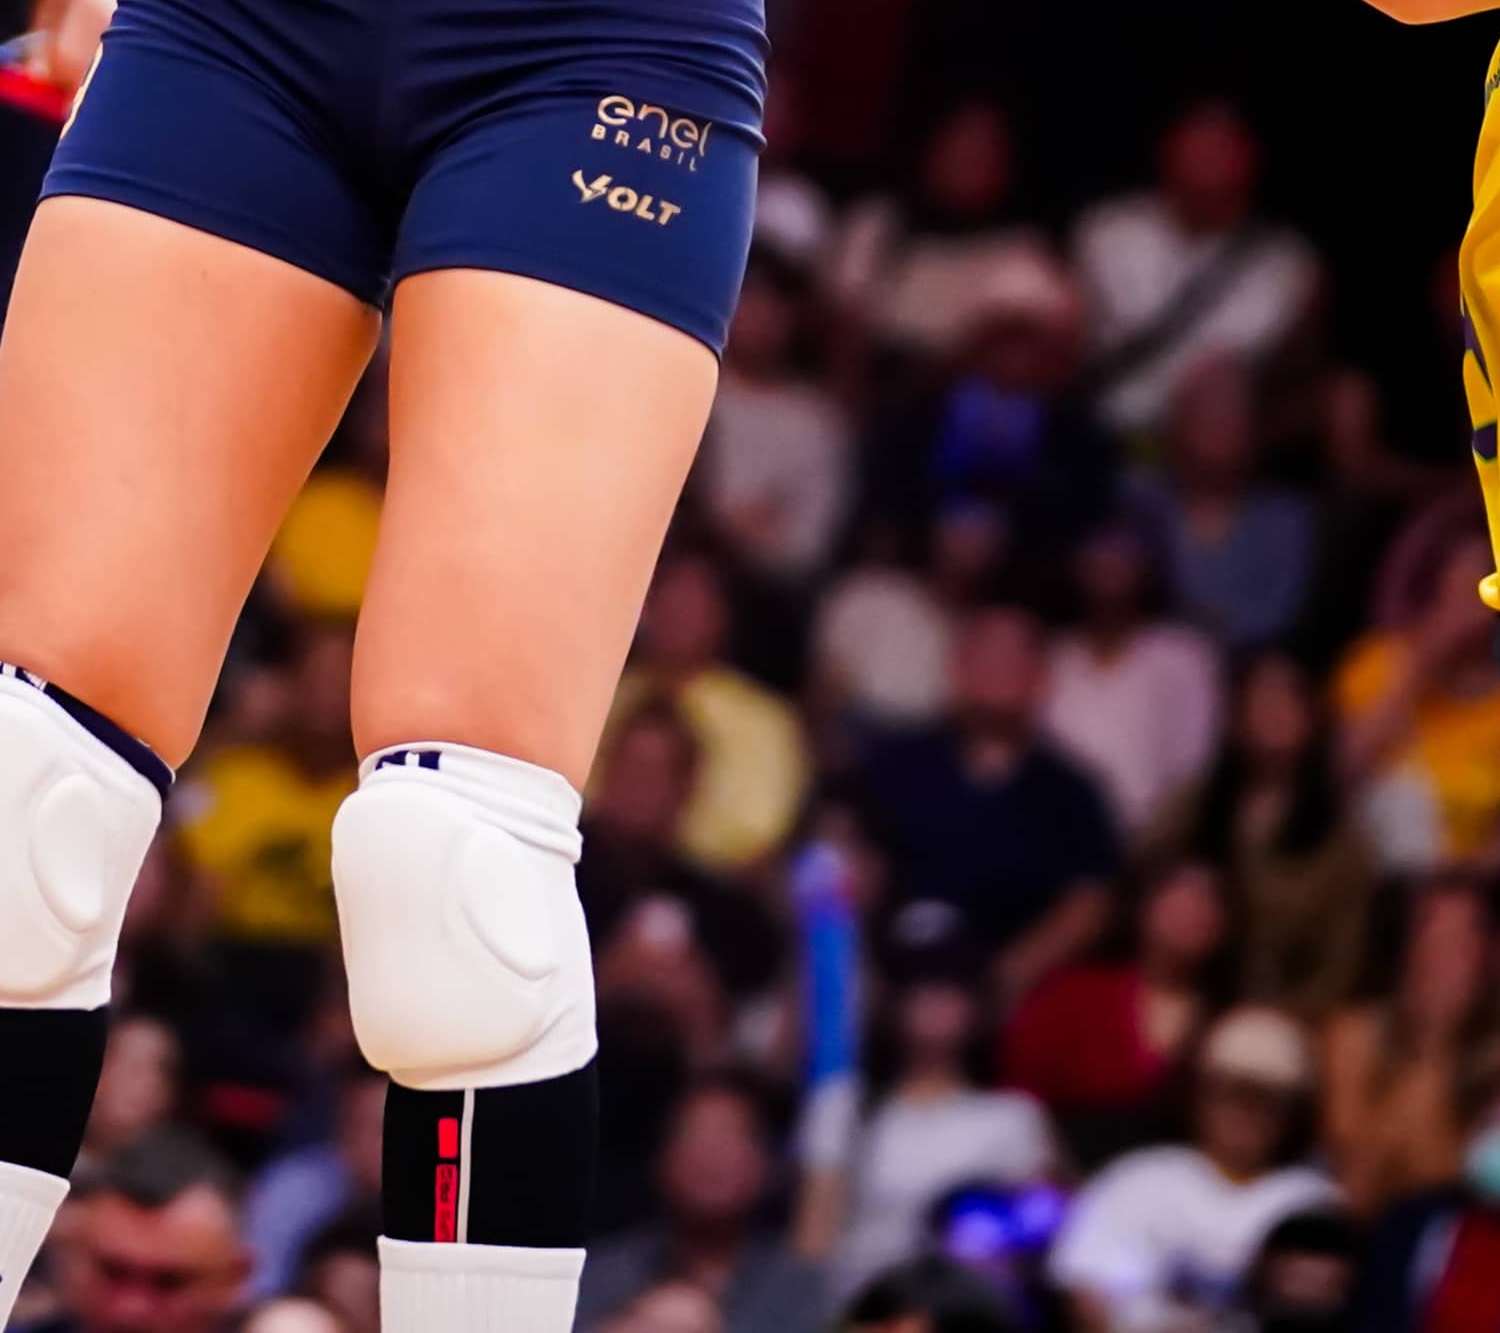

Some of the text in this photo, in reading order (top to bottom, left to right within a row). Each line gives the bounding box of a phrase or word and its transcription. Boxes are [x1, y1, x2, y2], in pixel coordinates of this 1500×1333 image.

[590, 123, 697, 172] BRASIL
[597, 94, 713, 158] enel
[572, 169, 681, 226] VOLT
